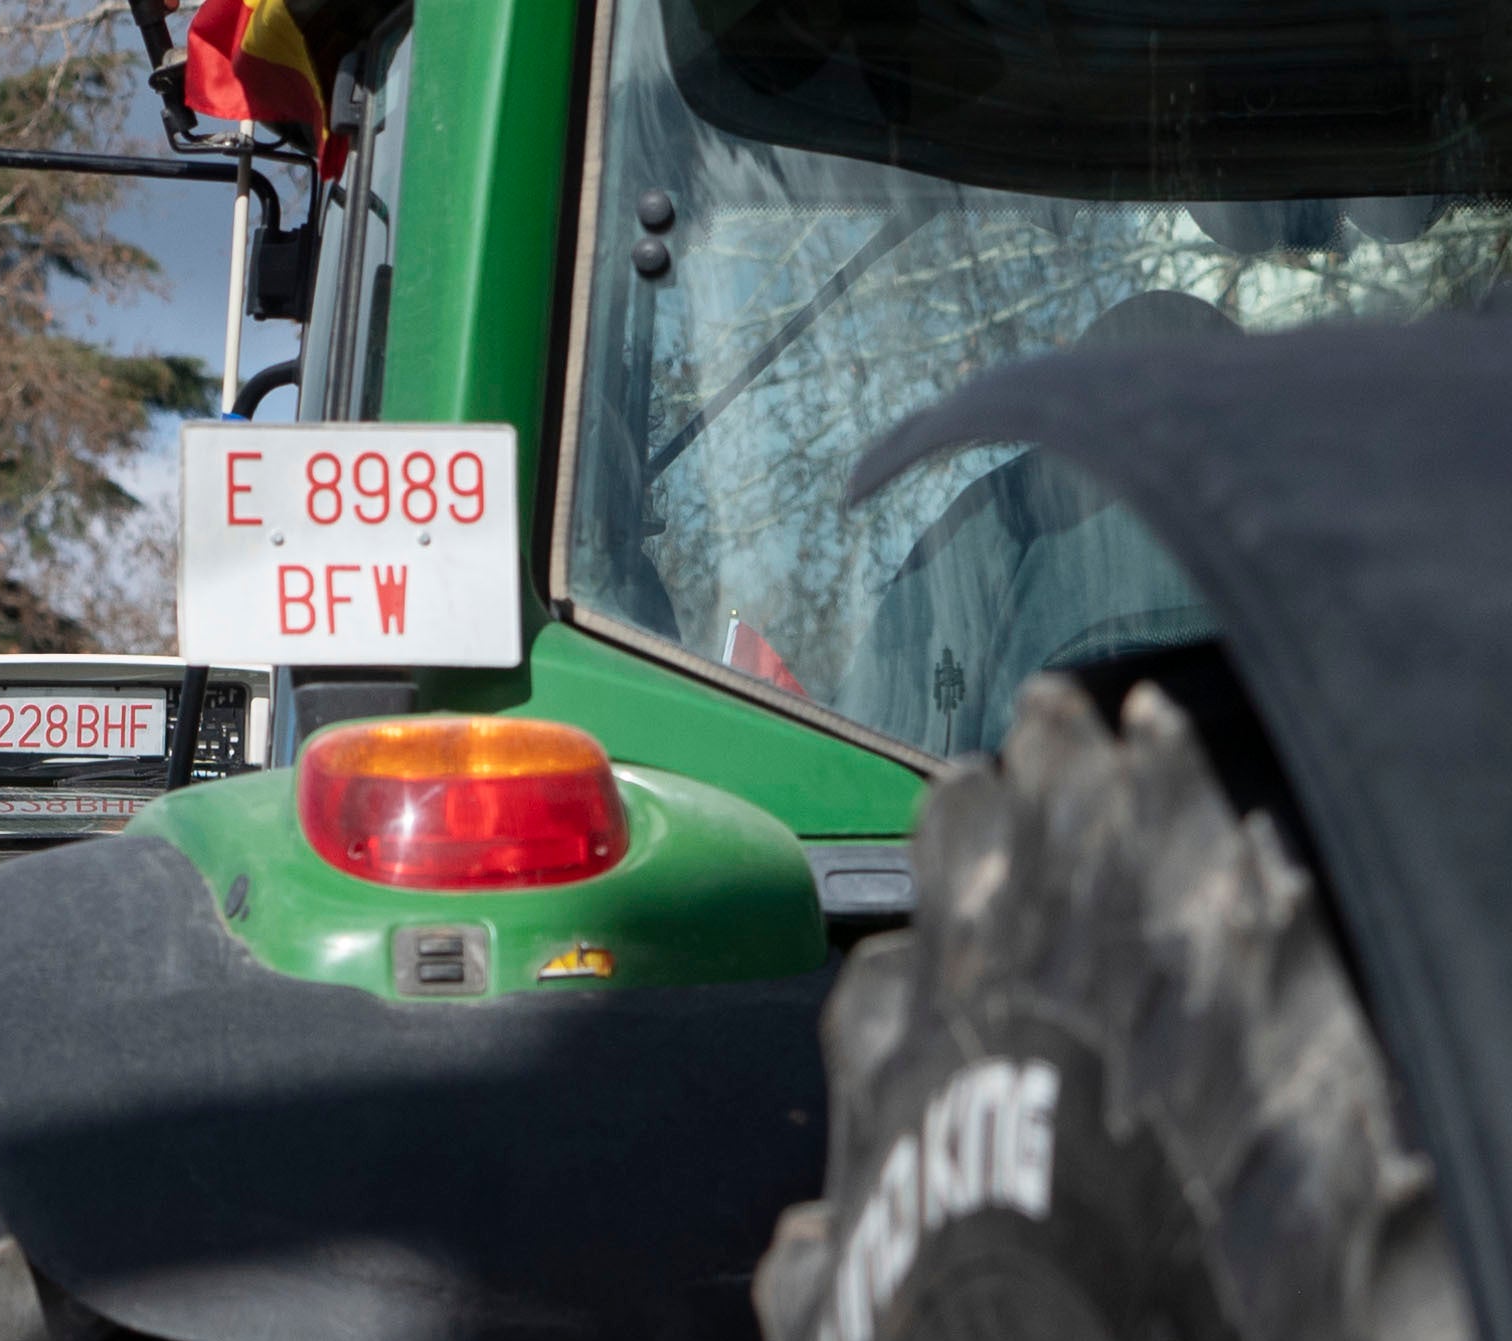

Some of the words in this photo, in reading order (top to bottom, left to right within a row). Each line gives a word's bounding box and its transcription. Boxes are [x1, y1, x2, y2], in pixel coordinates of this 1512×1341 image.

[227, 452, 262, 526] E
[306, 451, 485, 525] 8989
[278, 565, 408, 635] BFW
